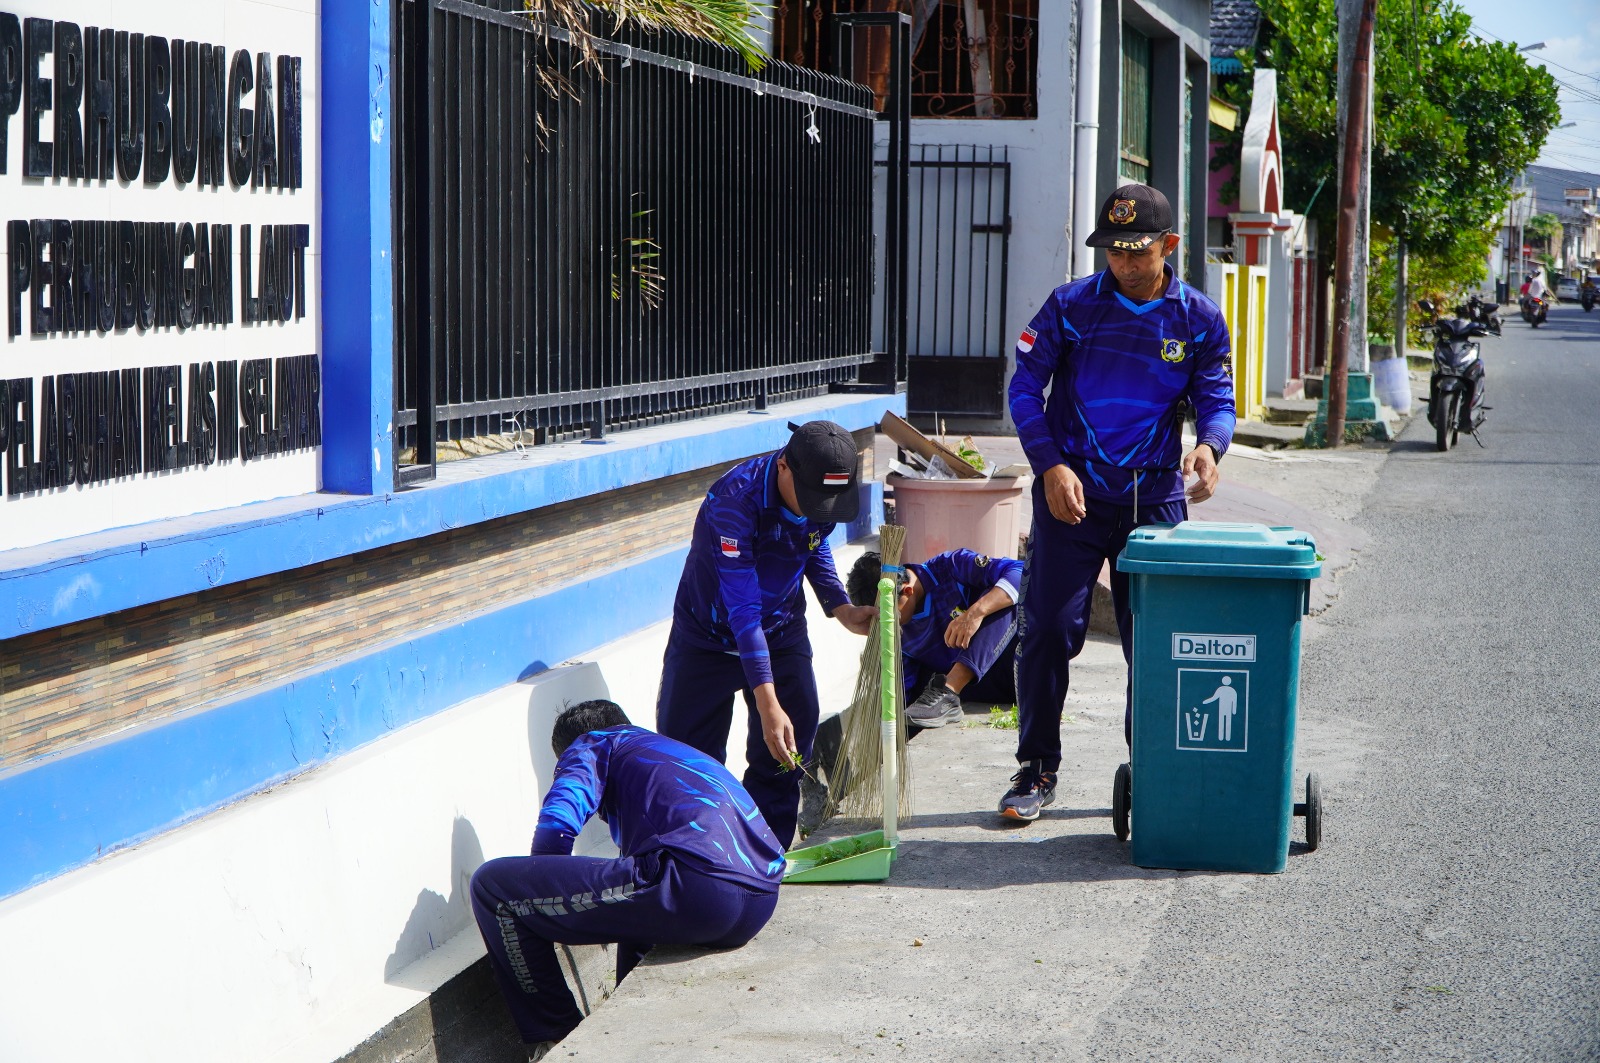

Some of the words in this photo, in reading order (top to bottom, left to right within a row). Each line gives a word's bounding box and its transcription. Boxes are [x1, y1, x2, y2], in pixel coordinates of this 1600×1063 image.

[0, 12, 302, 189] PERHUBUNGAN
[7, 219, 233, 336] PERHUBUNGAN
[241, 224, 310, 324] LAUT
[1113, 240, 1142, 250] KPLP
[143, 361, 216, 473] KELAS
[239, 354, 322, 461] SELAYAR
